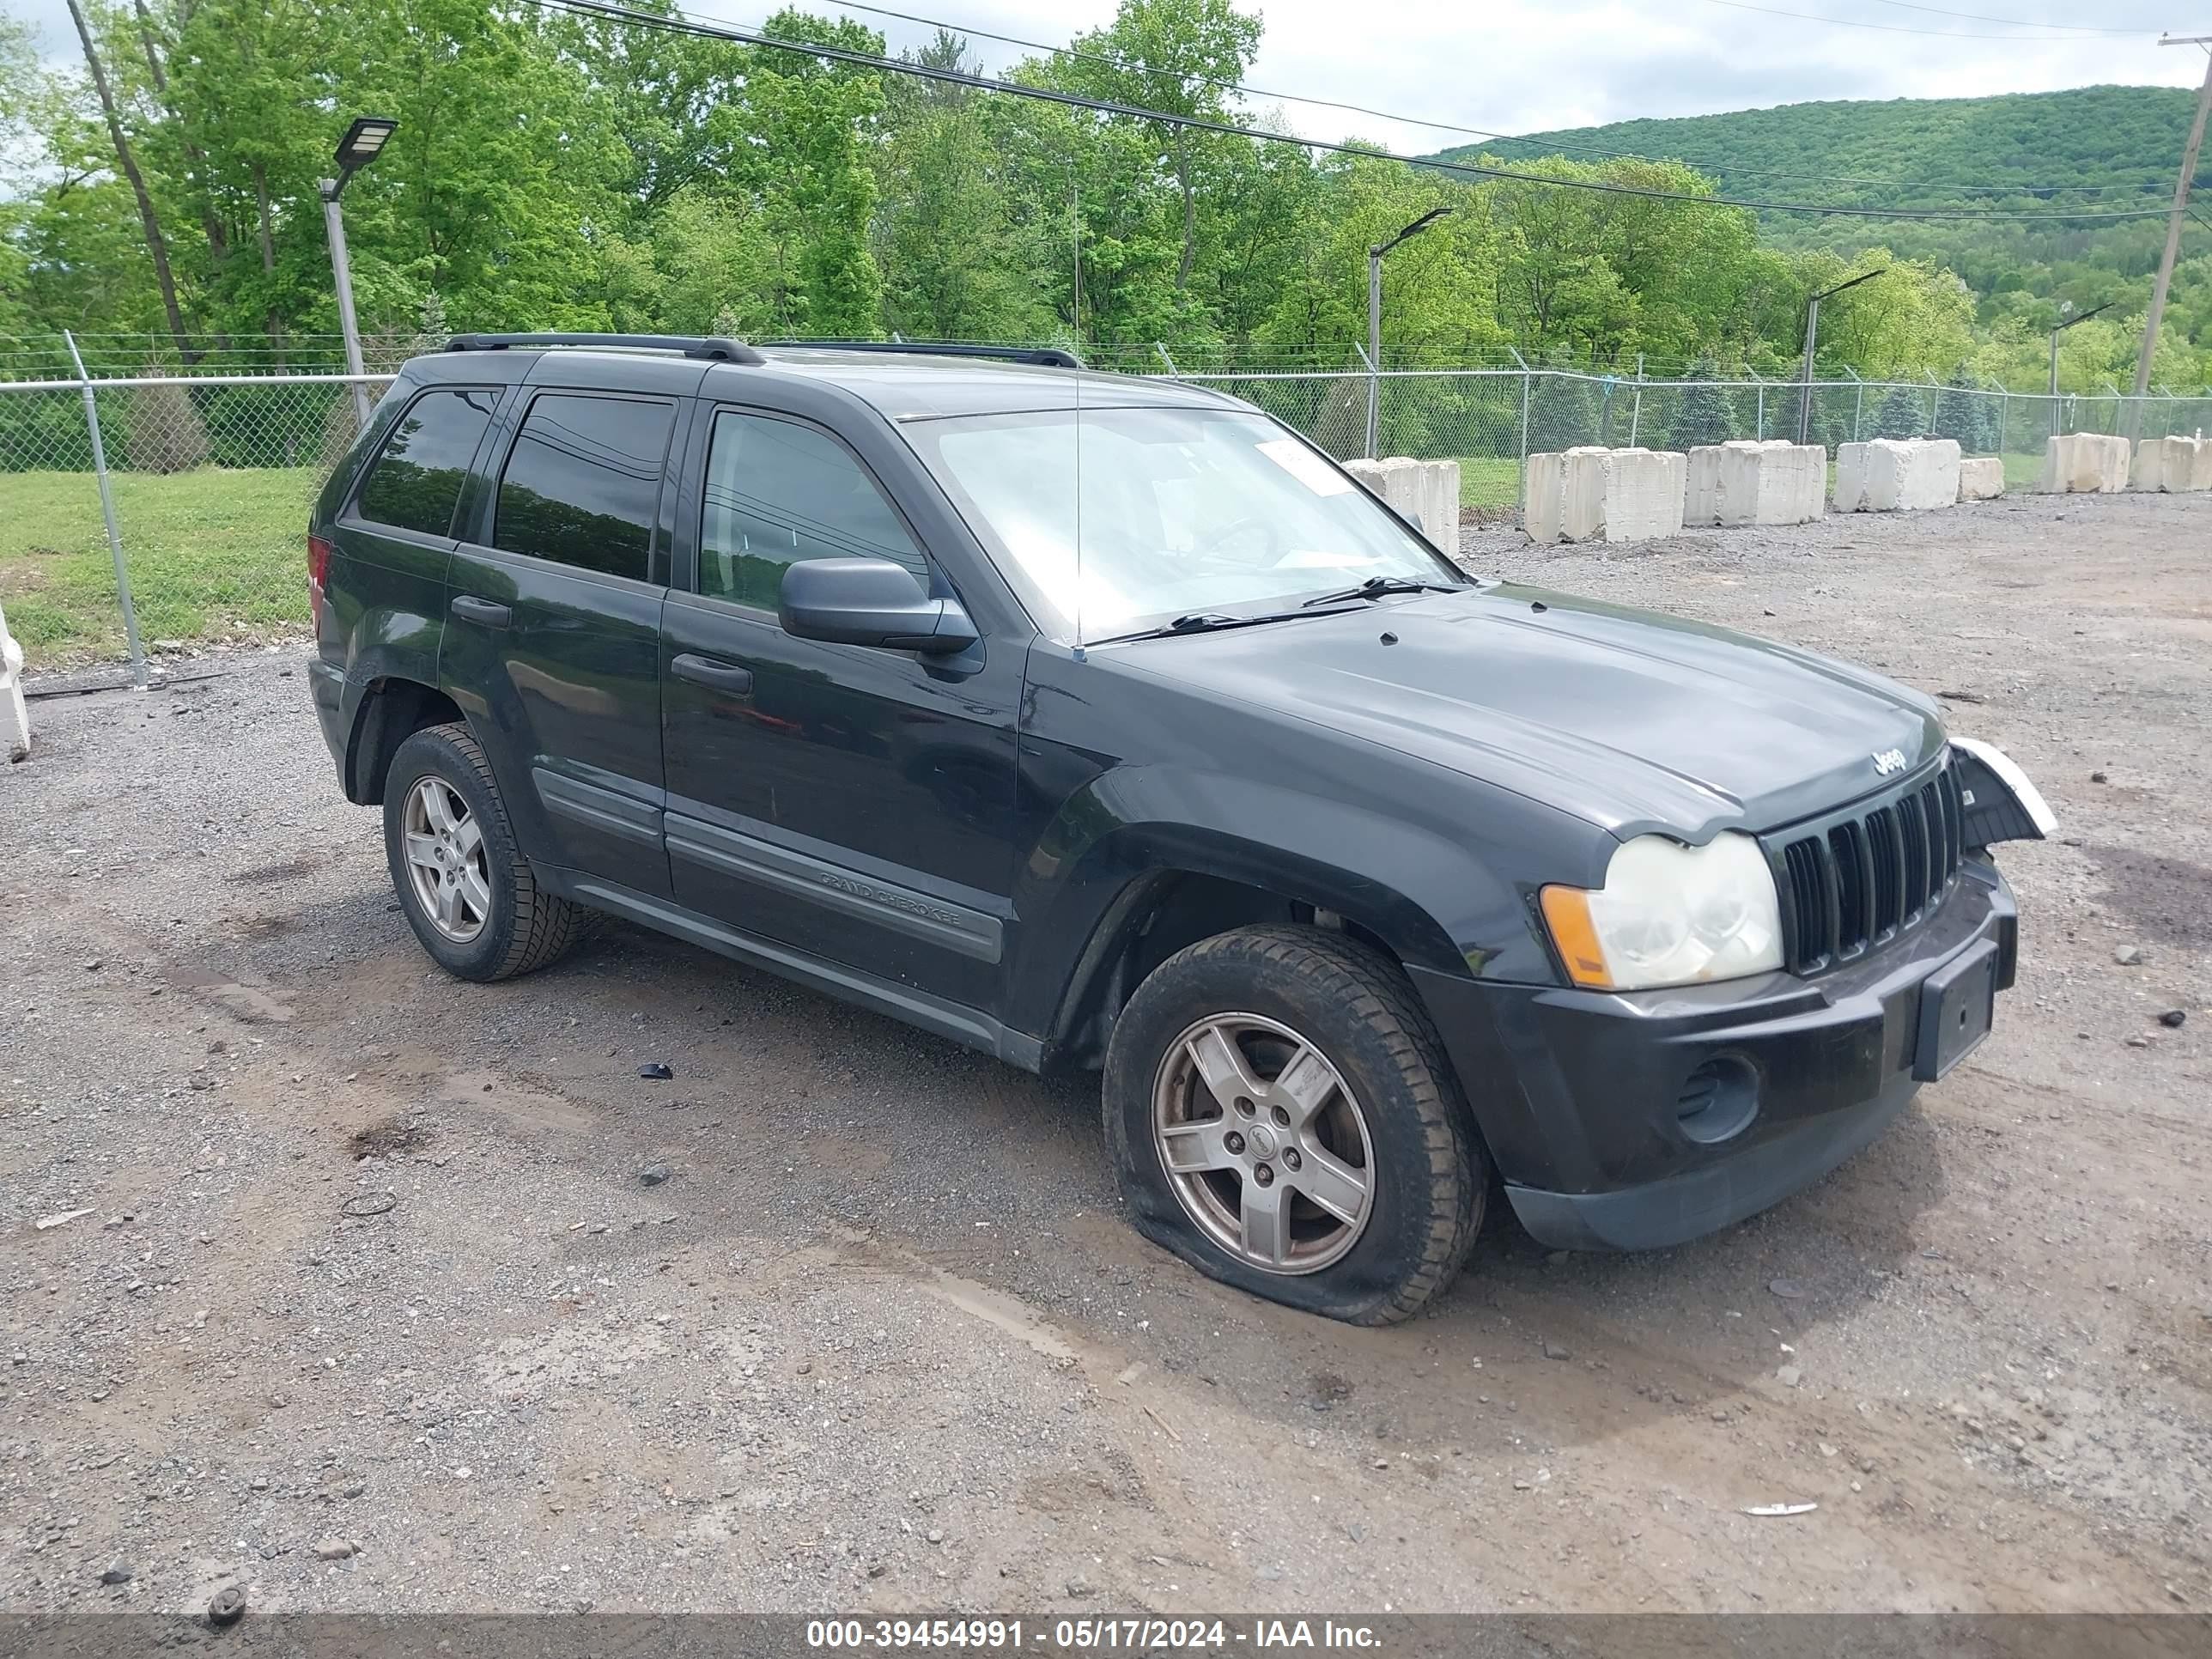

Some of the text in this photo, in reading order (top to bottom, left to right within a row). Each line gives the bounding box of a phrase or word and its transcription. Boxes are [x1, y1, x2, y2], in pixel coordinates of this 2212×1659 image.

[1871, 748, 1906, 775] Jeep
[820, 872, 961, 926] GRAND CHEROKEE
